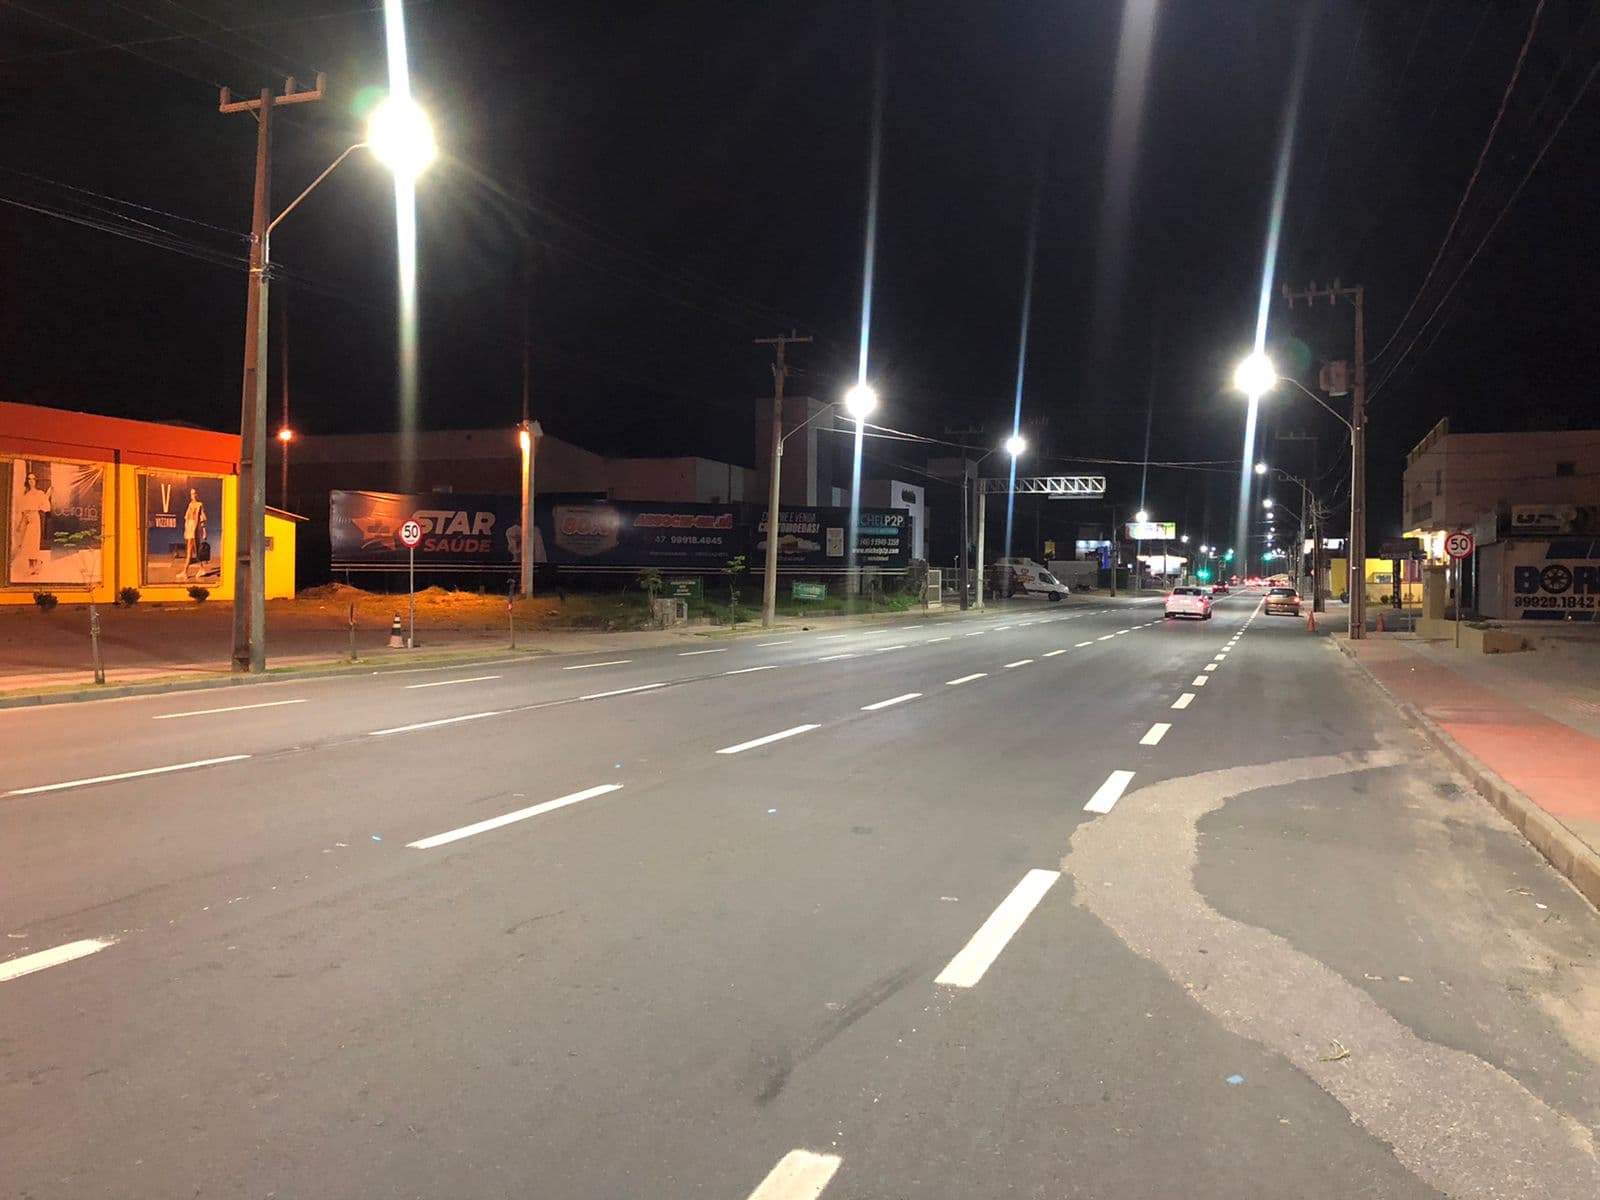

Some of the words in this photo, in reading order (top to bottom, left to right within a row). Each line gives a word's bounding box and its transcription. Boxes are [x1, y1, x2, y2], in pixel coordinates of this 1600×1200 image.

[411, 509, 496, 535] STAR
[404, 524, 419, 538] 50
[423, 535, 493, 553] SAÚDE
[1450, 537, 1469, 551] 50
